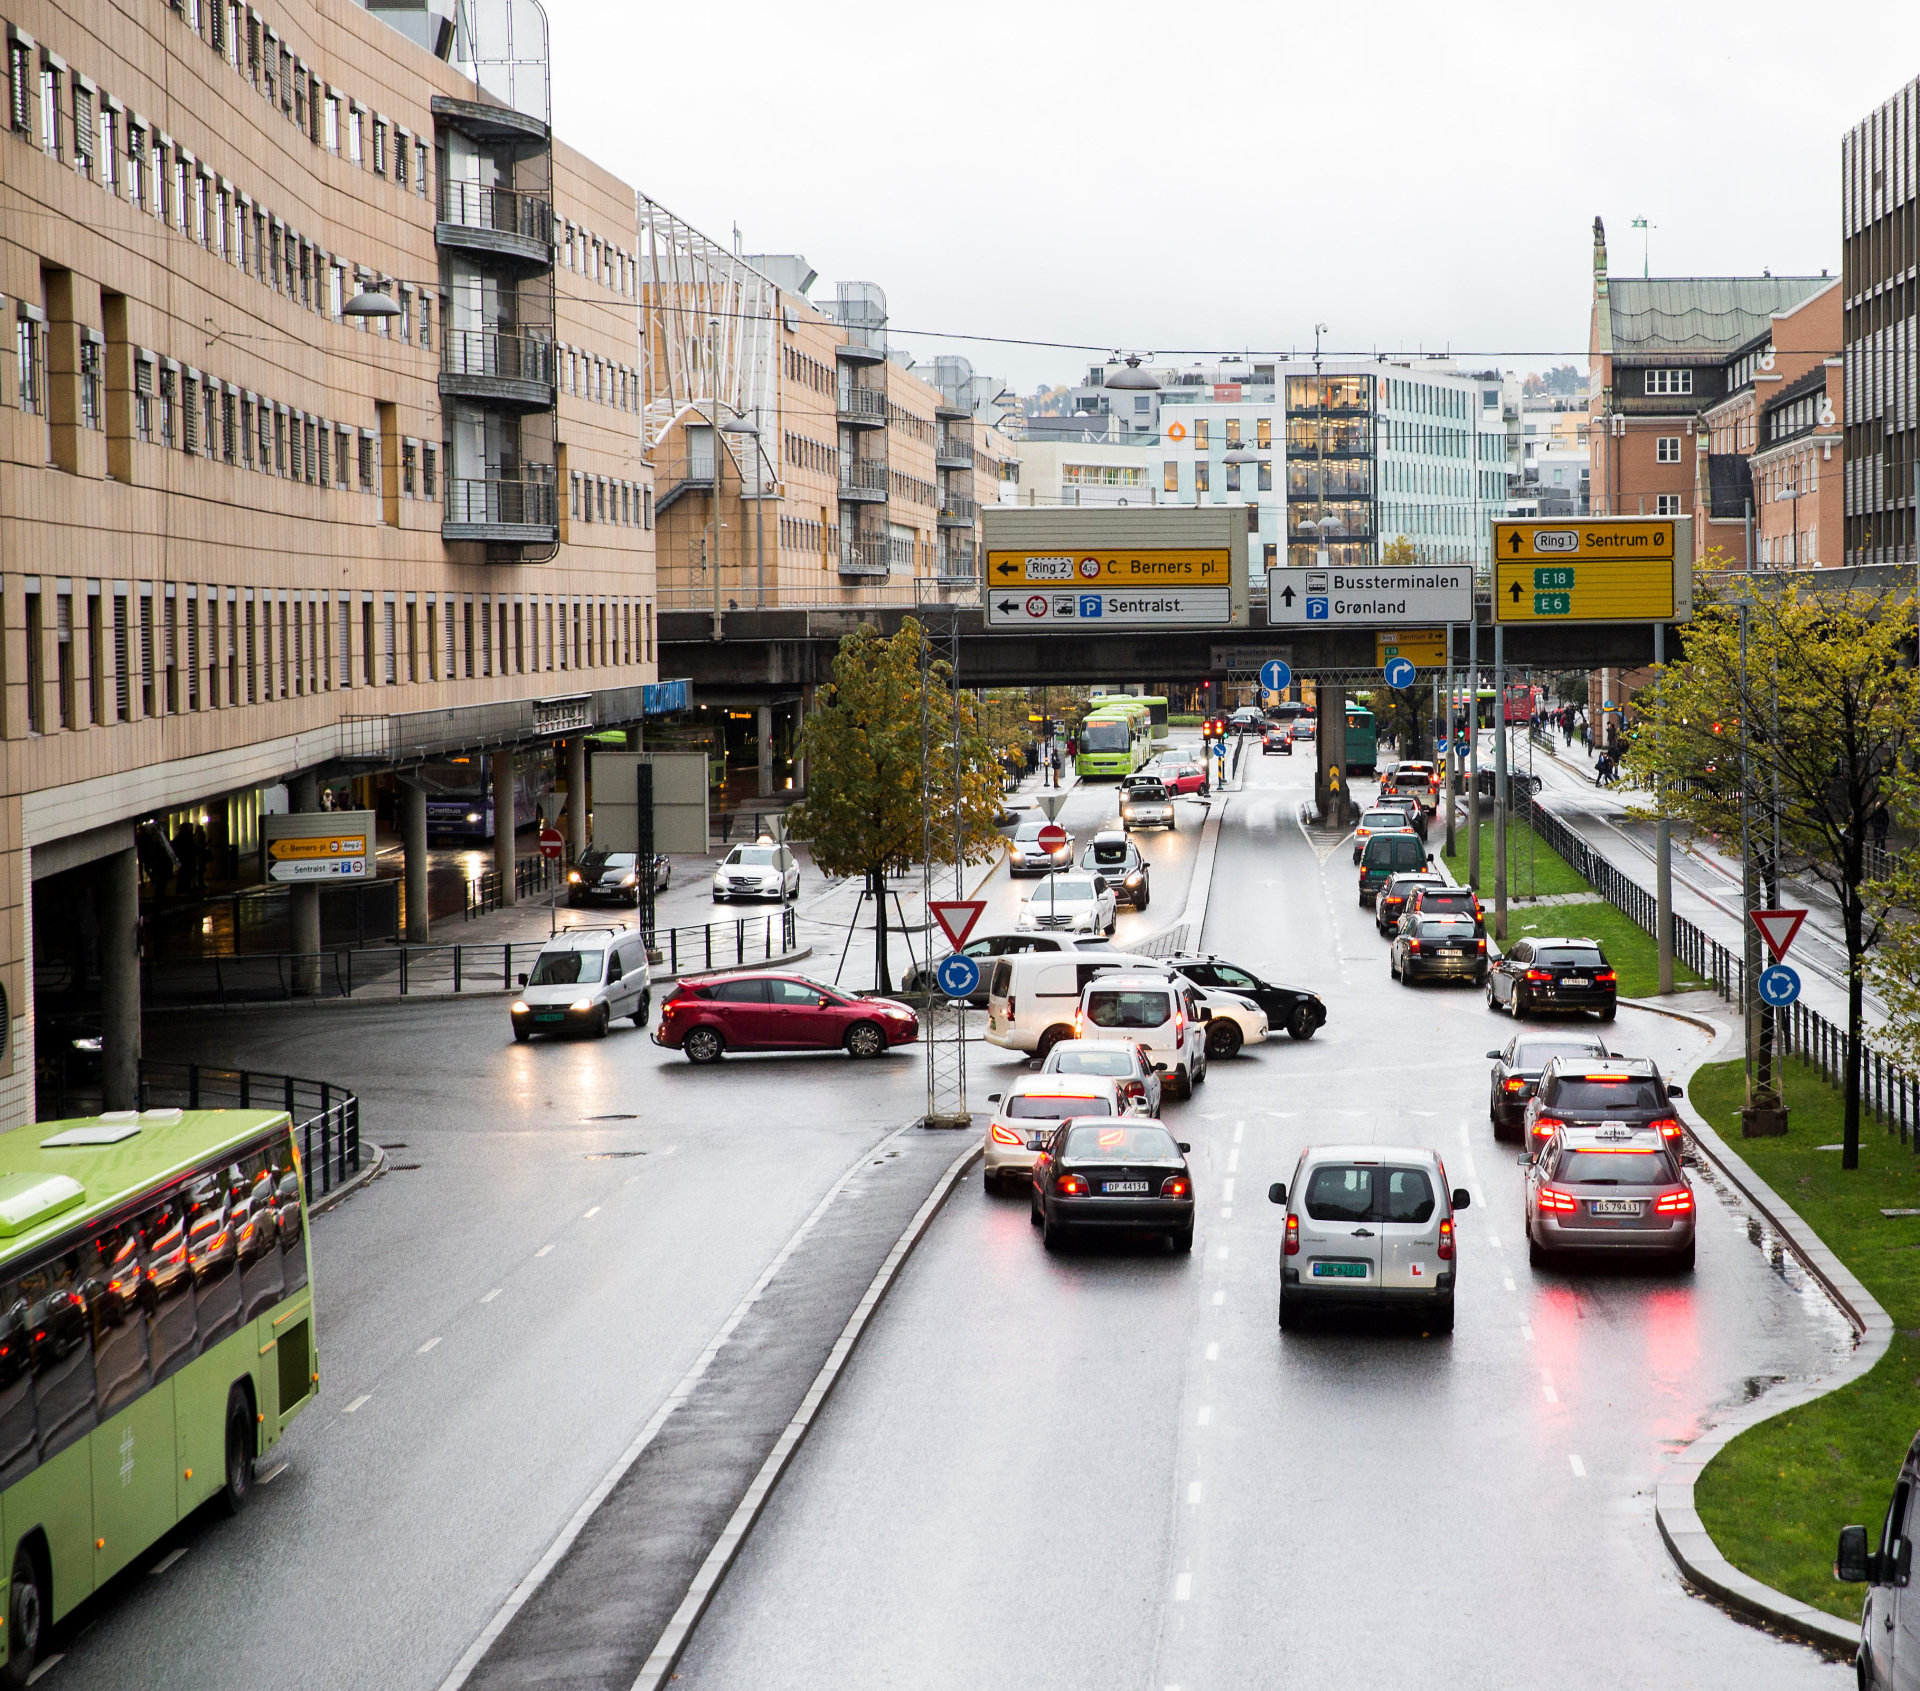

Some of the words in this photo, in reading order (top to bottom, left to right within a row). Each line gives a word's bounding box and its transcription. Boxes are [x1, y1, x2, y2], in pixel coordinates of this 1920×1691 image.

[1541, 535, 1564, 548] Ring
[1568, 534, 1572, 545] 1
[1586, 533, 1648, 547] Sentrum
[1653, 532, 1664, 546] Ø
[1032, 562, 1056, 574] Ring
[1060, 562, 1067, 573] 2
[1107, 560, 1121, 574] C.
[1130, 560, 1192, 574] Berners
[1201, 559, 1219, 576] pl.
[1334, 575, 1459, 589] Bussterminalen
[1542, 573, 1549, 584] E
[1553, 573, 1566, 584] 18
[1108, 598, 1184, 613] Sentralst.
[1334, 600, 1406, 614] Grønland
[1542, 598, 1549, 609] E
[1553, 598, 1562, 609] 6
[290, 844, 317, 852] Berners
[1109, 1183, 1119, 1191] DP
[1122, 1182, 1146, 1191] 44134
[1612, 1203, 1637, 1211] 79433
[1321, 1265, 1334, 1273] DN
[1337, 1266, 1365, 1275] 62958
[1412, 1265, 1421, 1275] L
